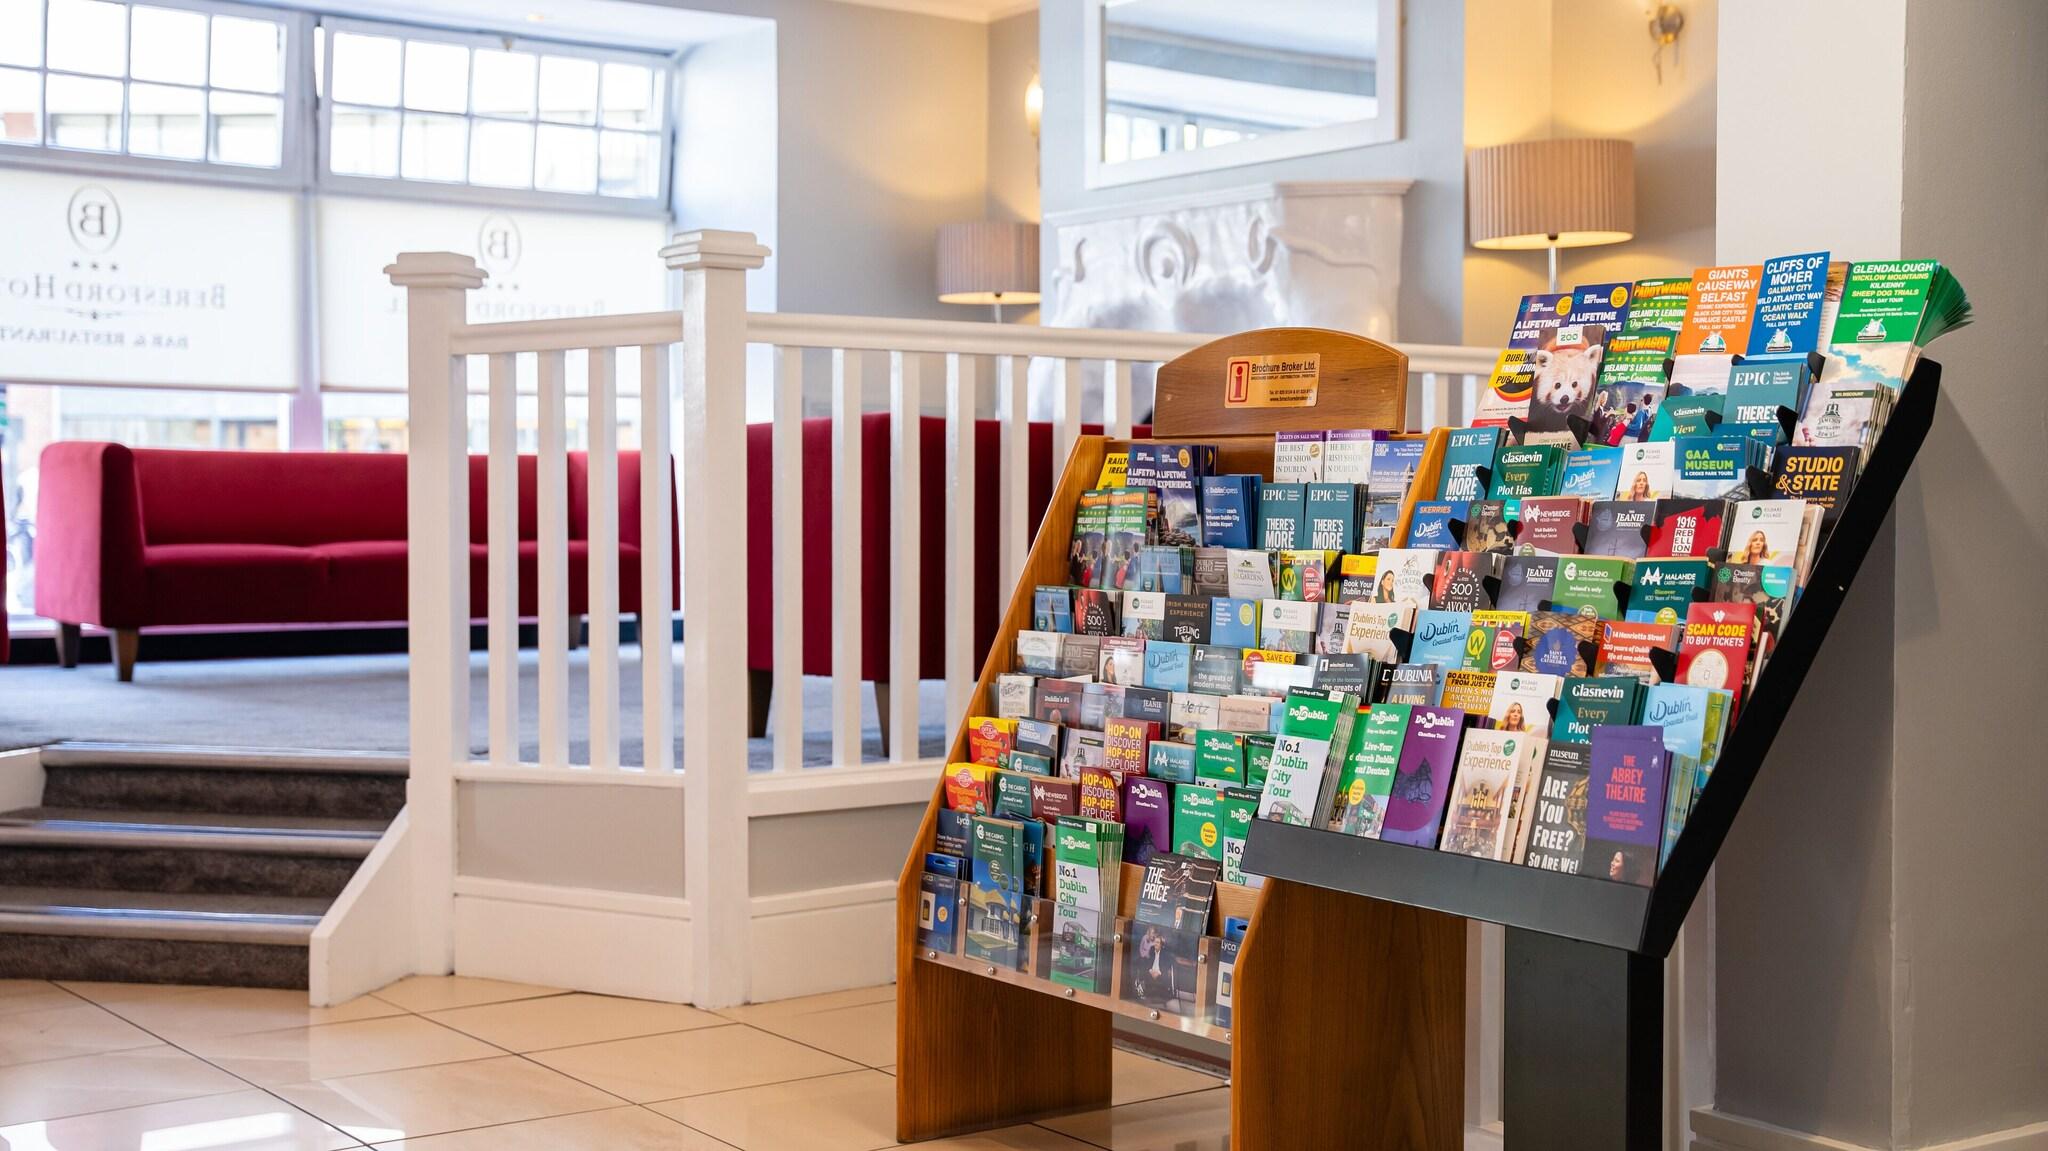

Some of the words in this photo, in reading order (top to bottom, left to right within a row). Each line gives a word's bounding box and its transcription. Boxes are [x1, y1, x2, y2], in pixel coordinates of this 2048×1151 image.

[1767, 258, 1804, 275] CLIFFS
[1807, 256, 1824, 270] OF
[1853, 262, 1933, 274] GLENDALOUGH
[1708, 269, 1749, 280] GIANTS
[1771, 270, 1813, 286] MOHER
[1852, 274, 1885, 282] WICKLOW
[1887, 272, 1929, 281] MOUNTAINS
[1696, 280, 1758, 292] CAUSEWAY
[1768, 286, 1793, 296] GALWAY
[1795, 284, 1813, 293] CITY
[1701, 292, 1748, 304] BELFAST
[1852, 290, 1874, 298] SHEEP
[1876, 289, 1893, 297] DOG
[1895, 288, 1919, 297] TRIALS
[1760, 304, 1792, 313] ATLANTIC
[1794, 302, 1814, 310] EDGE
[1570, 313, 1577, 322] A
[1577, 311, 1617, 322] LIFETIME
[1762, 312, 1786, 322] OCEAN
[1788, 311, 1809, 320] WALK
[1515, 321, 1522, 330] A
[1522, 319, 1562, 330] LIFETIME
[1505, 353, 1532, 362] DUBLIN
[1252, 363, 1280, 373] Brochure
[1282, 361, 1302, 372] Broker
[1304, 360, 1316, 370] Ltd.
[1513, 373, 1532, 383] TOUR
[1734, 371, 1770, 386] EPIC
[1451, 434, 1478, 448] EPIC
[1502, 451, 1542, 464] Glasnevin
[1686, 450, 1710, 460] GAA
[1283, 465, 1308, 473] DUBLIN
[1685, 460, 1734, 470] MUSEUM
[1785, 456, 1844, 473] STUDIO
[1161, 470, 1187, 479] LIFETIME
[1157, 480, 1192, 488] EXPERIENCE
[1446, 478, 1478, 496] MORE
[1497, 486, 1513, 496] Plot
[1515, 485, 1533, 496] Has
[1776, 474, 1803, 496] &
[1792, 474, 1840, 491] STATE
[1263, 489, 1286, 501] EPIC
[1311, 489, 1335, 502] EPIC
[1616, 512, 1646, 523] JEANIE
[1677, 516, 1697, 528] 1916
[1266, 518, 1295, 531] THERE'S
[1313, 518, 1344, 532] THERE'S
[1265, 530, 1295, 549] MORE
[1675, 529, 1693, 538] REB
[1312, 532, 1344, 550] MORE
[1673, 544, 1690, 552] ION
[1526, 567, 1554, 579] JEANIE
[1578, 569, 1587, 577] THE
[1588, 570, 1609, 578] CASINO
[1664, 573, 1697, 581] MALAHIDE
[1733, 569, 1756, 577] Chester
[1343, 579, 1358, 587] Book
[1450, 583, 1473, 596] 300
[1343, 587, 1361, 595] Dublin
[1087, 615, 1102, 626] 300
[1169, 610, 1205, 618] EXPERIENCE
[1174, 625, 1200, 639] TEELING
[1420, 622, 1459, 642] Dublin
[1619, 631, 1647, 641] Henrietta
[1647, 634, 1666, 642] Street
[1687, 623, 1716, 636] SCAN
[1717, 625, 1747, 637] CODE
[1686, 637, 1695, 645] TO
[1696, 638, 1712, 646] BUY
[1713, 638, 1745, 647] TICKETS
[1540, 658, 1568, 666] CATHEDRAL
[1208, 674, 1225, 682] greats
[1227, 674, 1233, 682] of
[1392, 669, 1433, 682] DUBLINIA
[1193, 681, 1214, 689] modern
[1334, 685, 1353, 693] greats
[1355, 684, 1362, 692] of
[1469, 680, 1485, 688] JUST
[1572, 683, 1625, 699] Glasnevin
[1045, 695, 1062, 703] Dublin's
[1143, 701, 1162, 709] JEANIE
[1392, 694, 1398, 704] A
[1398, 694, 1426, 704] LIVING
[1578, 706, 1609, 723] Every
[1107, 723, 1142, 739] HOP-ON
[1568, 721, 1590, 734] Plot
[1106, 736, 1141, 750] DISCOVER
[1278, 738, 1300, 754] No.1
[1106, 746, 1141, 761] HOP-OFF
[1355, 753, 1375, 762] durch
[1375, 754, 1395, 764] Dublin
[1550, 748, 1579, 760] museum
[1105, 757, 1140, 773] EXPLORE
[1273, 754, 1308, 770] Dublin
[1463, 752, 1511, 771] Experience
[1082, 772, 1114, 789] HOP-ON
[1271, 768, 1292, 784] City
[1611, 767, 1644, 785] ABBEY
[1081, 785, 1114, 799] DISCOVER
[1268, 784, 1291, 798] Tour
[1542, 775, 1568, 799] ARE
[1605, 783, 1648, 804] THEATRE
[1081, 796, 1115, 811] HOP-OFF
[1081, 806, 1115, 821] EXPLORE
[1539, 799, 1564, 825] YOU
[1532, 825, 1574, 851] FREE?
[1059, 864, 1077, 878] No.1
[1147, 866, 1166, 885] THE
[1227, 871, 1247, 885] City
[1059, 878, 1088, 894] Dublin
[1142, 882, 1170, 903] PRICE
[1060, 891, 1077, 907] City
[1058, 904, 1078, 919] Tour
